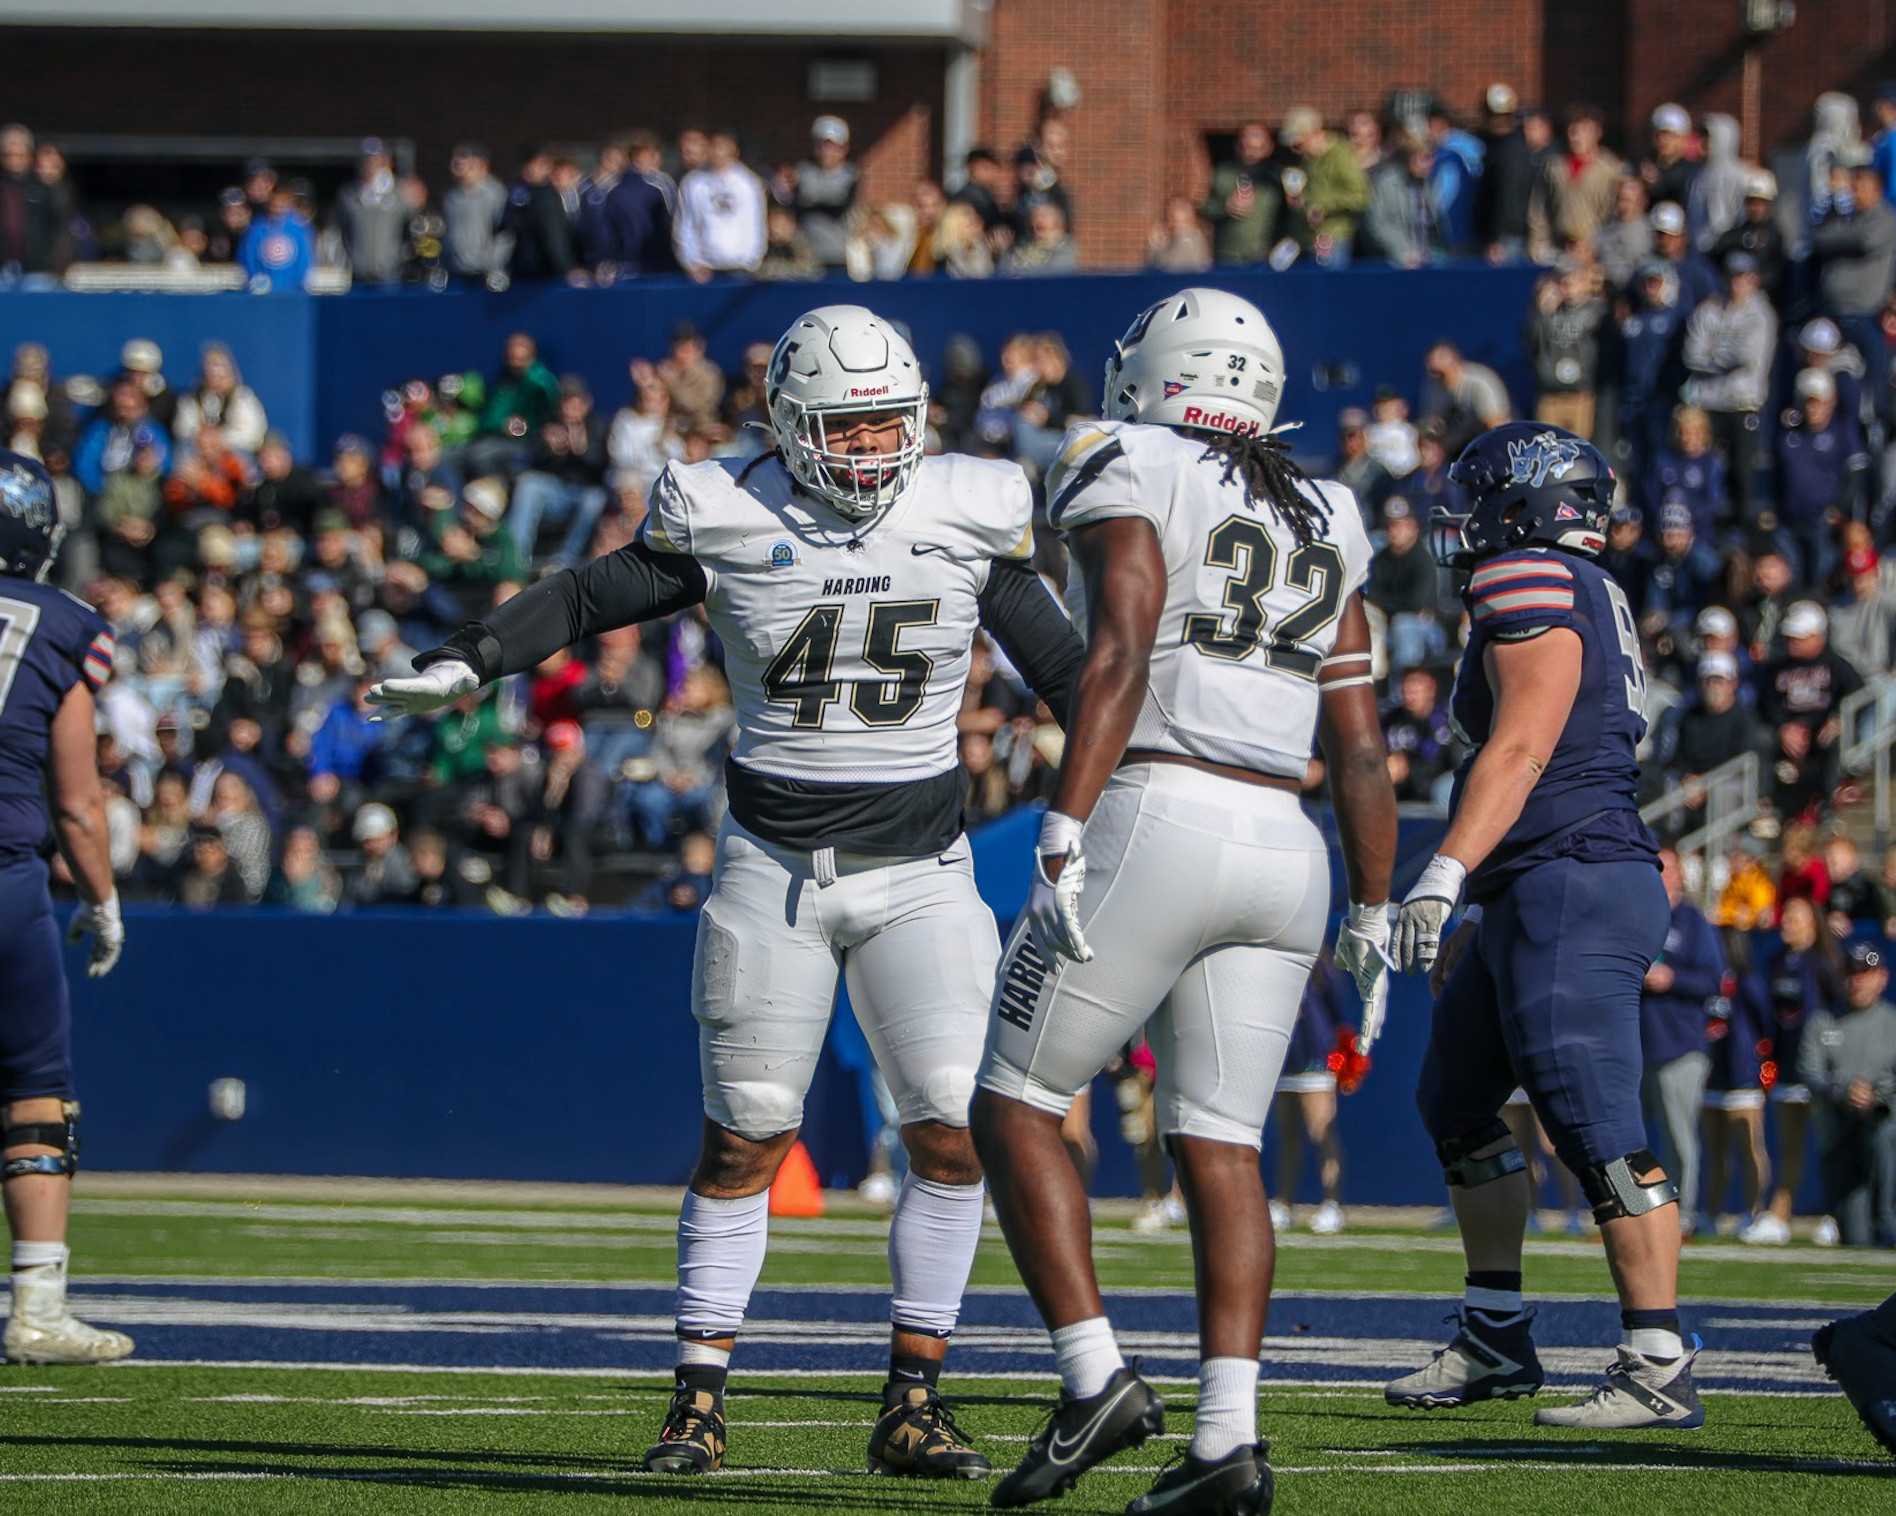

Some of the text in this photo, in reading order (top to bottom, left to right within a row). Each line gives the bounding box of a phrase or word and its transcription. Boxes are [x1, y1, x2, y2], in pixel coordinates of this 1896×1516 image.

[1227, 354, 1247, 373] 32
[850, 385, 889, 397] Riddell
[774, 548, 791, 561] 50
[821, 575, 891, 596] HARDING
[1181, 513, 1346, 681] 32
[761, 598, 940, 729] 45
[997, 931, 1048, 1033] HARD
